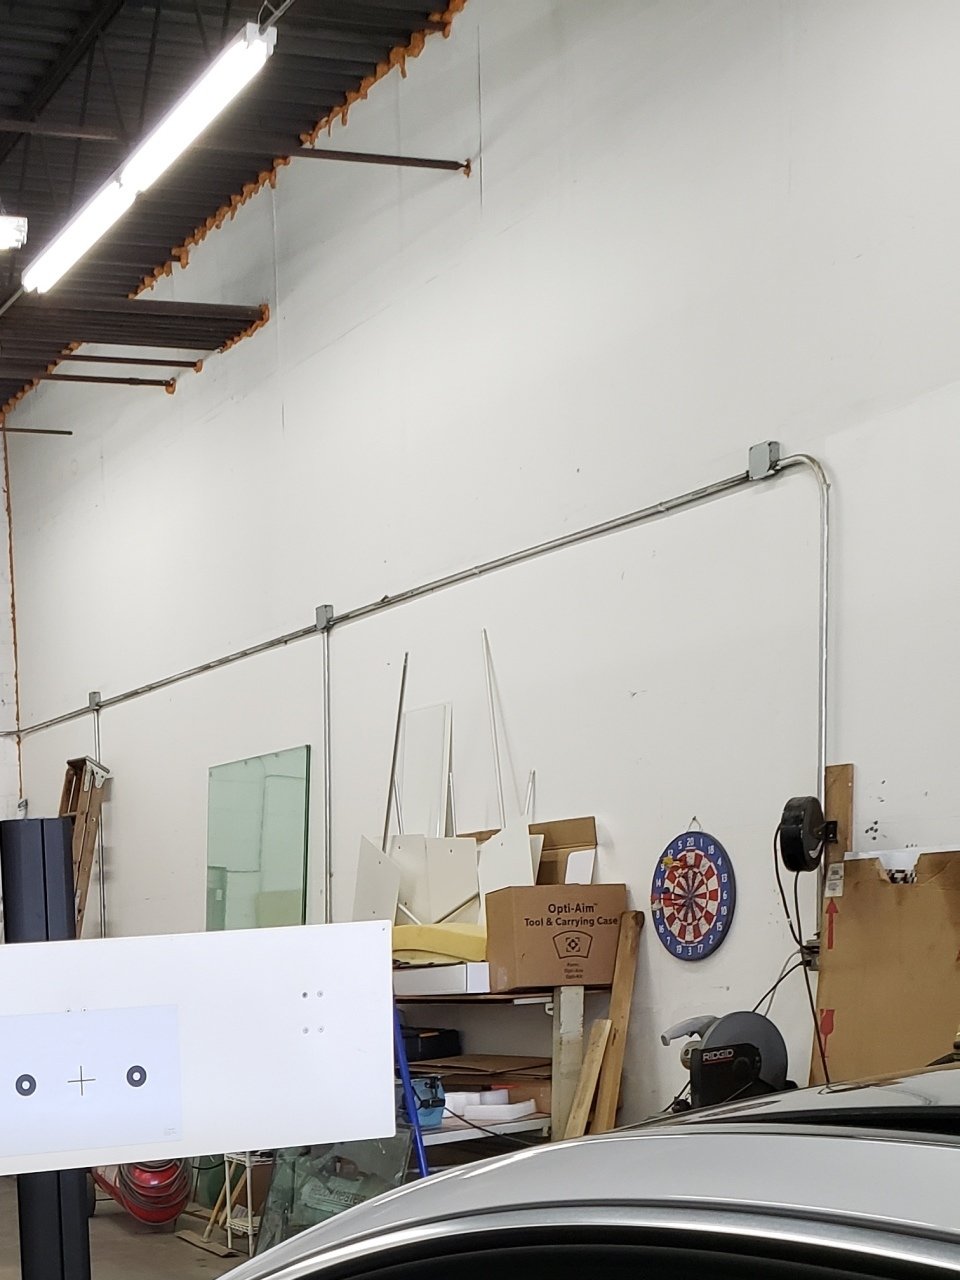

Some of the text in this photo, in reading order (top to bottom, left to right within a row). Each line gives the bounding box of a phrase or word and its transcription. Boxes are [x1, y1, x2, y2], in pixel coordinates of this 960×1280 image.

[524, 916, 619, 928] Tool & Carrying Case
[702, 1048, 734, 1062] RIDGID
